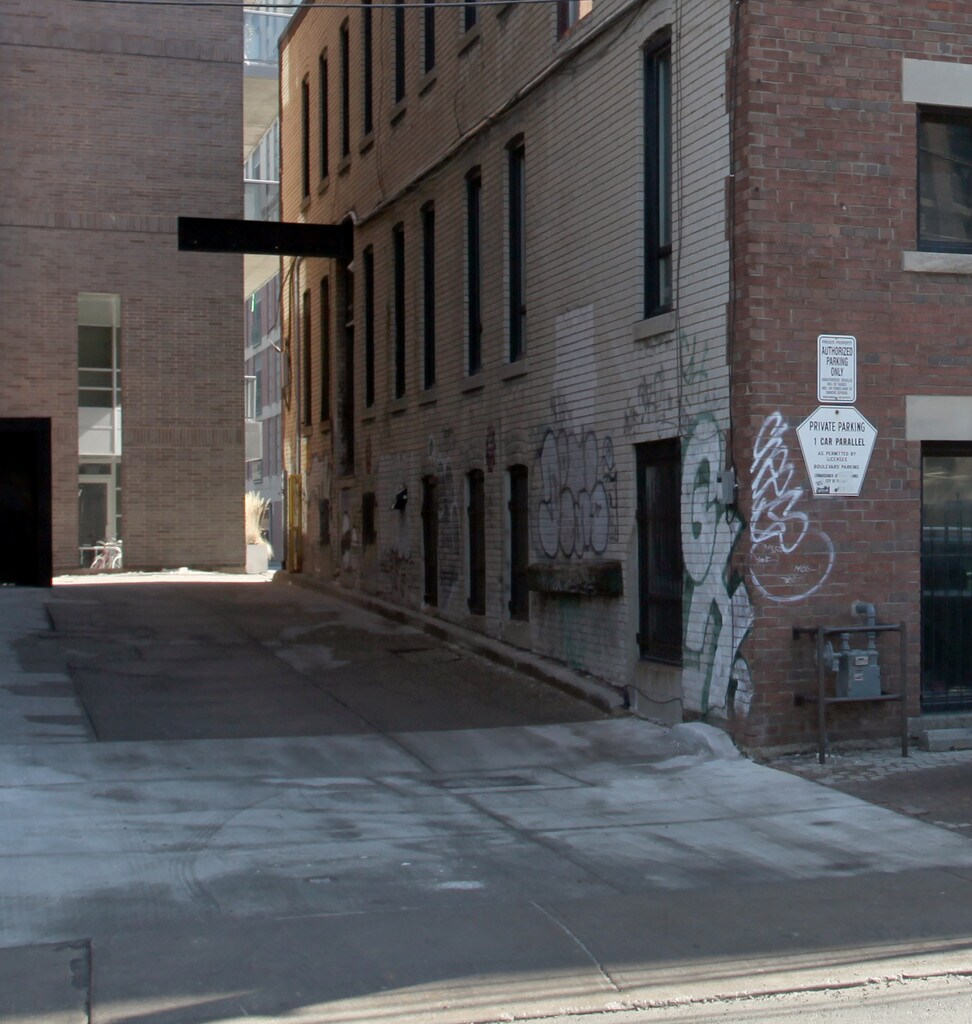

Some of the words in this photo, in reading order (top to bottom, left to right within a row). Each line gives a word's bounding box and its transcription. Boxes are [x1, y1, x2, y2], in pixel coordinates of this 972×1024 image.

[822, 346, 853, 356] AUTHORIZED
[826, 356, 848, 367] PARKING
[831, 367, 844, 377] ONLY
[809, 421, 836, 432] PRIVATE
[838, 422, 865, 432] PARKING
[814, 438, 817, 446] 1
[820, 437, 833, 446] CAR
[835, 438, 865, 447] PARALLEL
